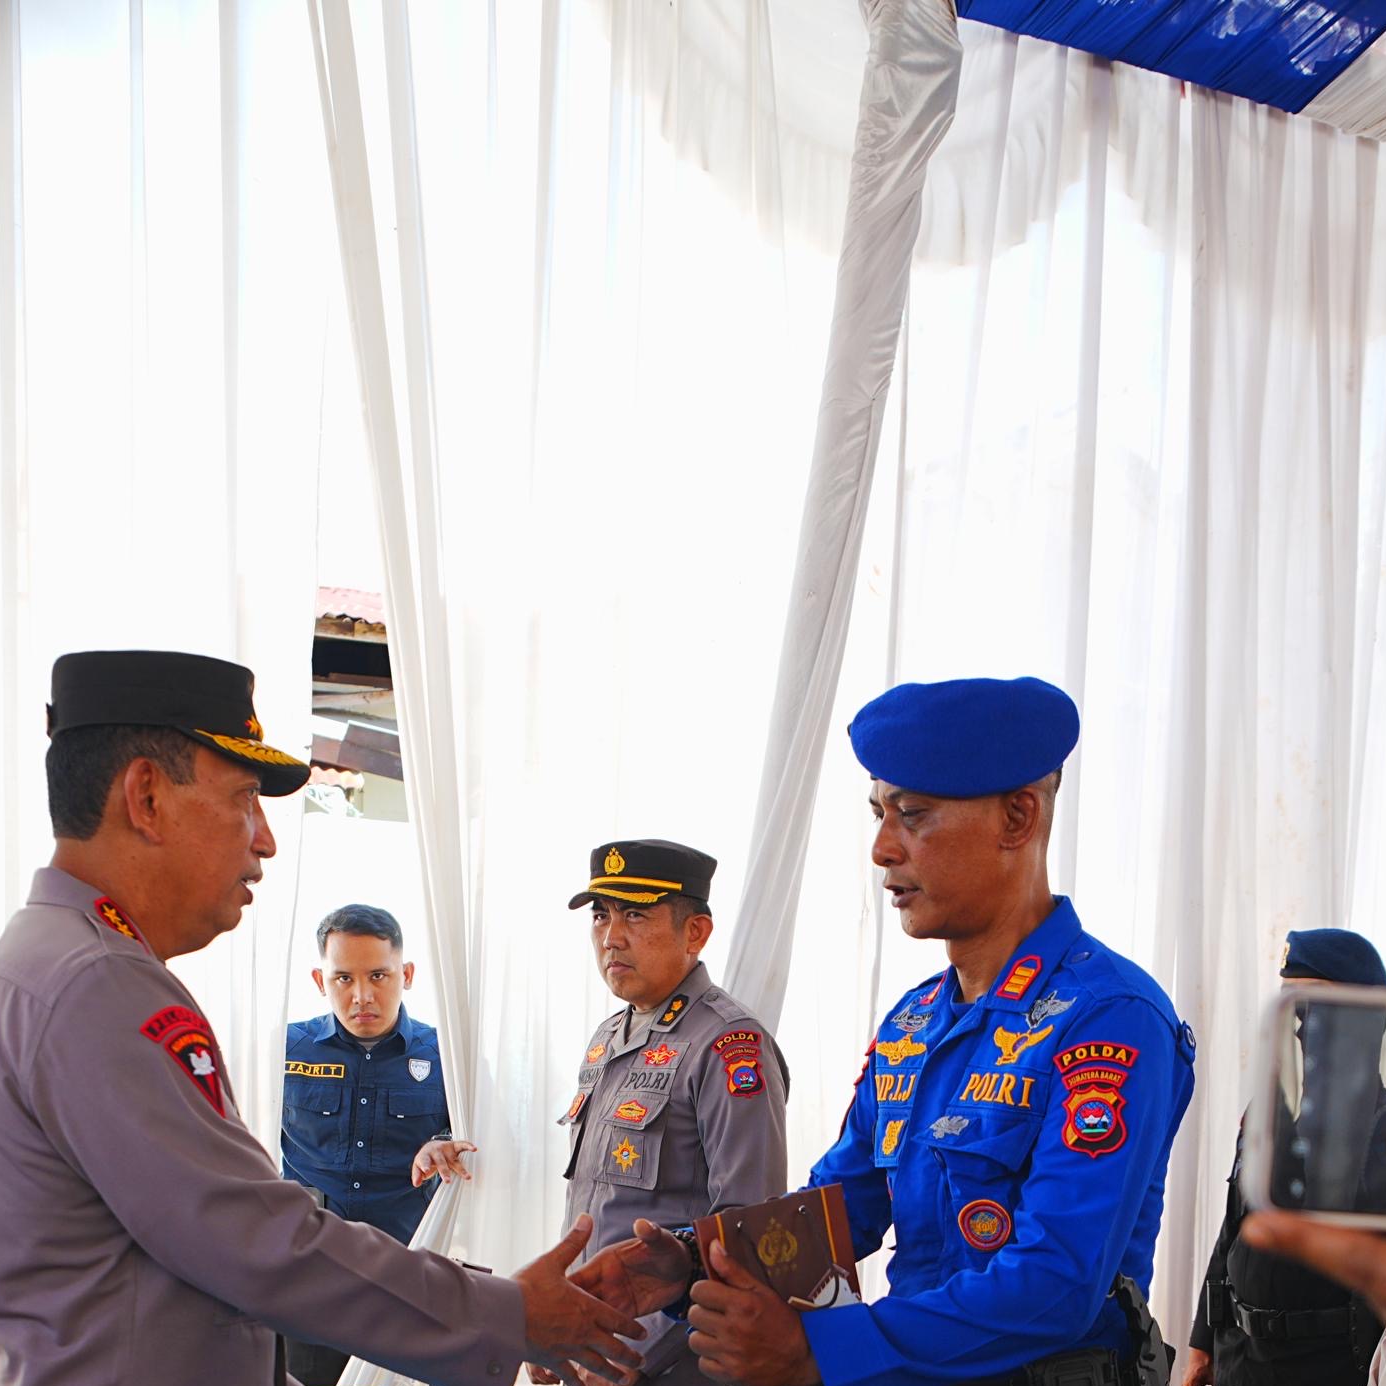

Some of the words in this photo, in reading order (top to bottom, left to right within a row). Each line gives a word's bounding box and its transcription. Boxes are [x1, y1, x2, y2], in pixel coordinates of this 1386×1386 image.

[716, 1032, 755, 1049] POLDA
[1062, 1045, 1127, 1066] POLDA
[289, 1063, 324, 1076] FAJRI
[329, 1066, 336, 1076] T
[1100, 1071, 1122, 1083] BARAT
[624, 1071, 672, 1091] POLRI
[959, 1072, 1036, 1108] POLRI
